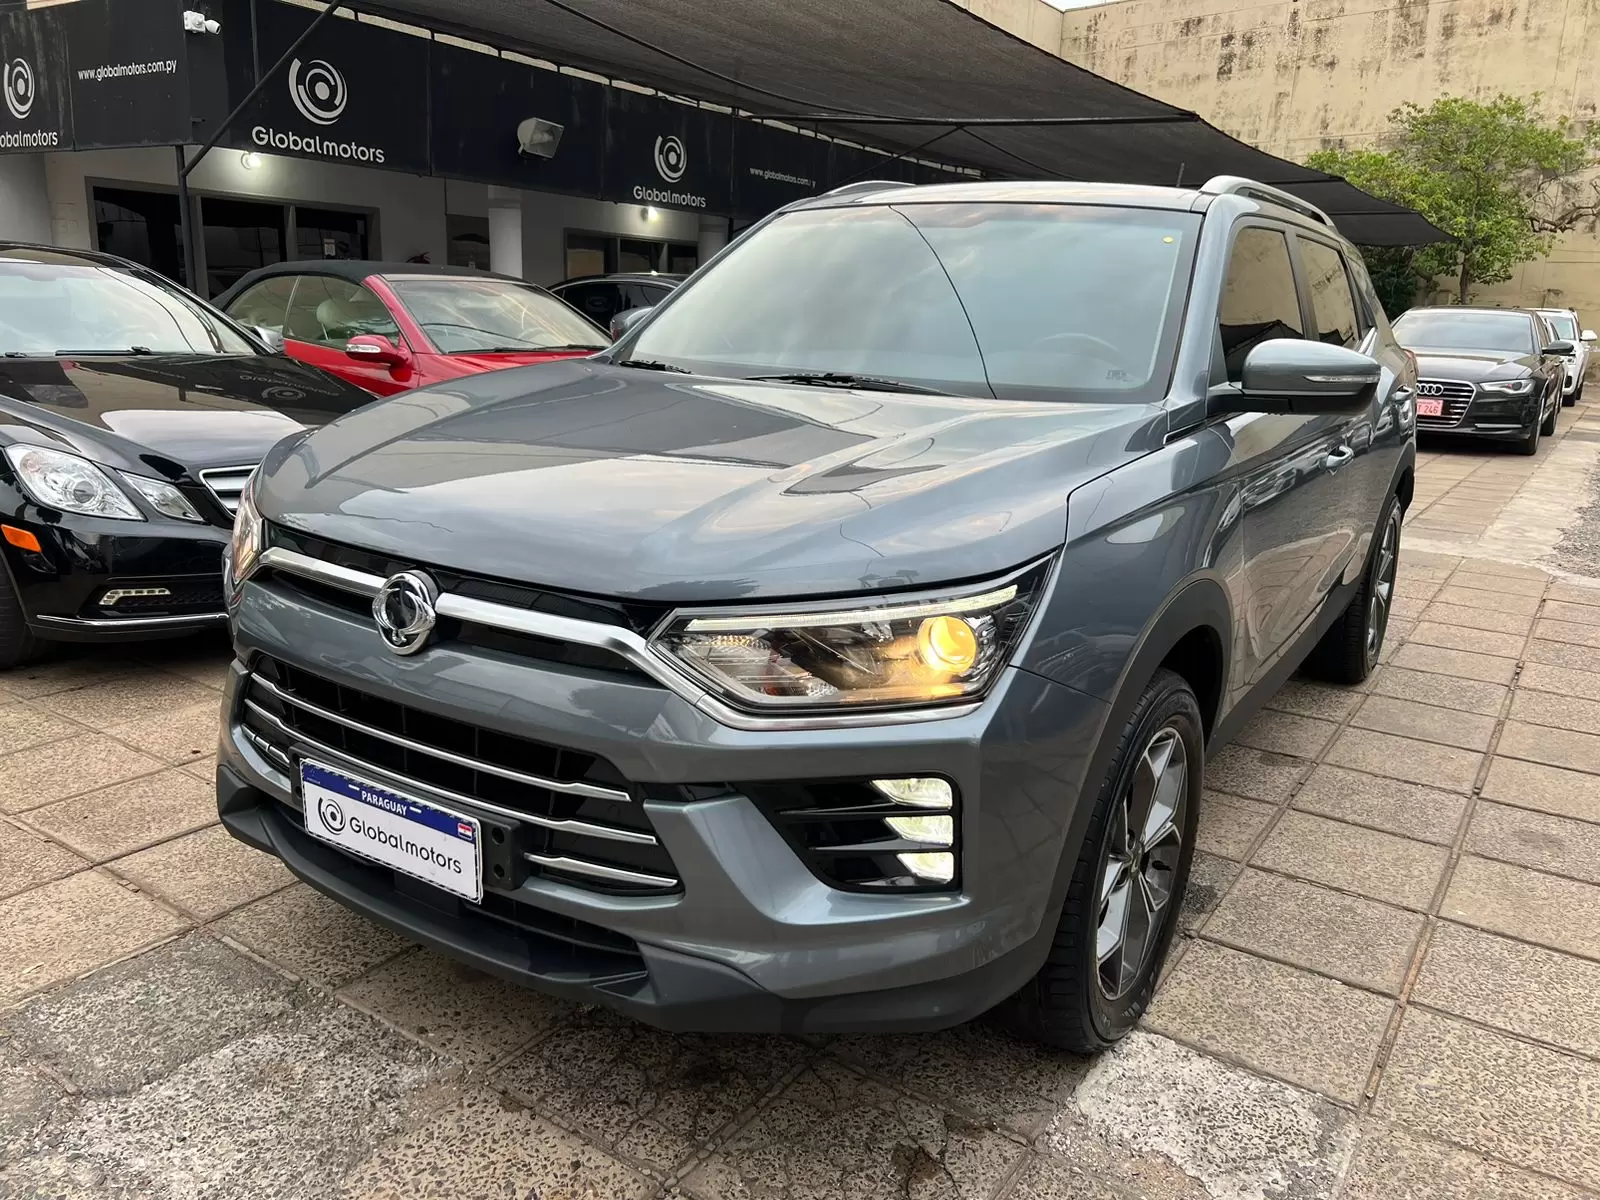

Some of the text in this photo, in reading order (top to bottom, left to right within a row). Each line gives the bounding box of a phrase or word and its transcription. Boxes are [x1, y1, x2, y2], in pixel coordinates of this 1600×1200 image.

[77, 59, 177, 82] www.globalmotors.com.py
[0, 129, 58, 148] obalmotors
[251, 125, 386, 164] Globalmotors
[633, 185, 707, 208] Globalmotors
[361, 790, 408, 816] PARAGUAY
[349, 816, 463, 874] Globalmotors
